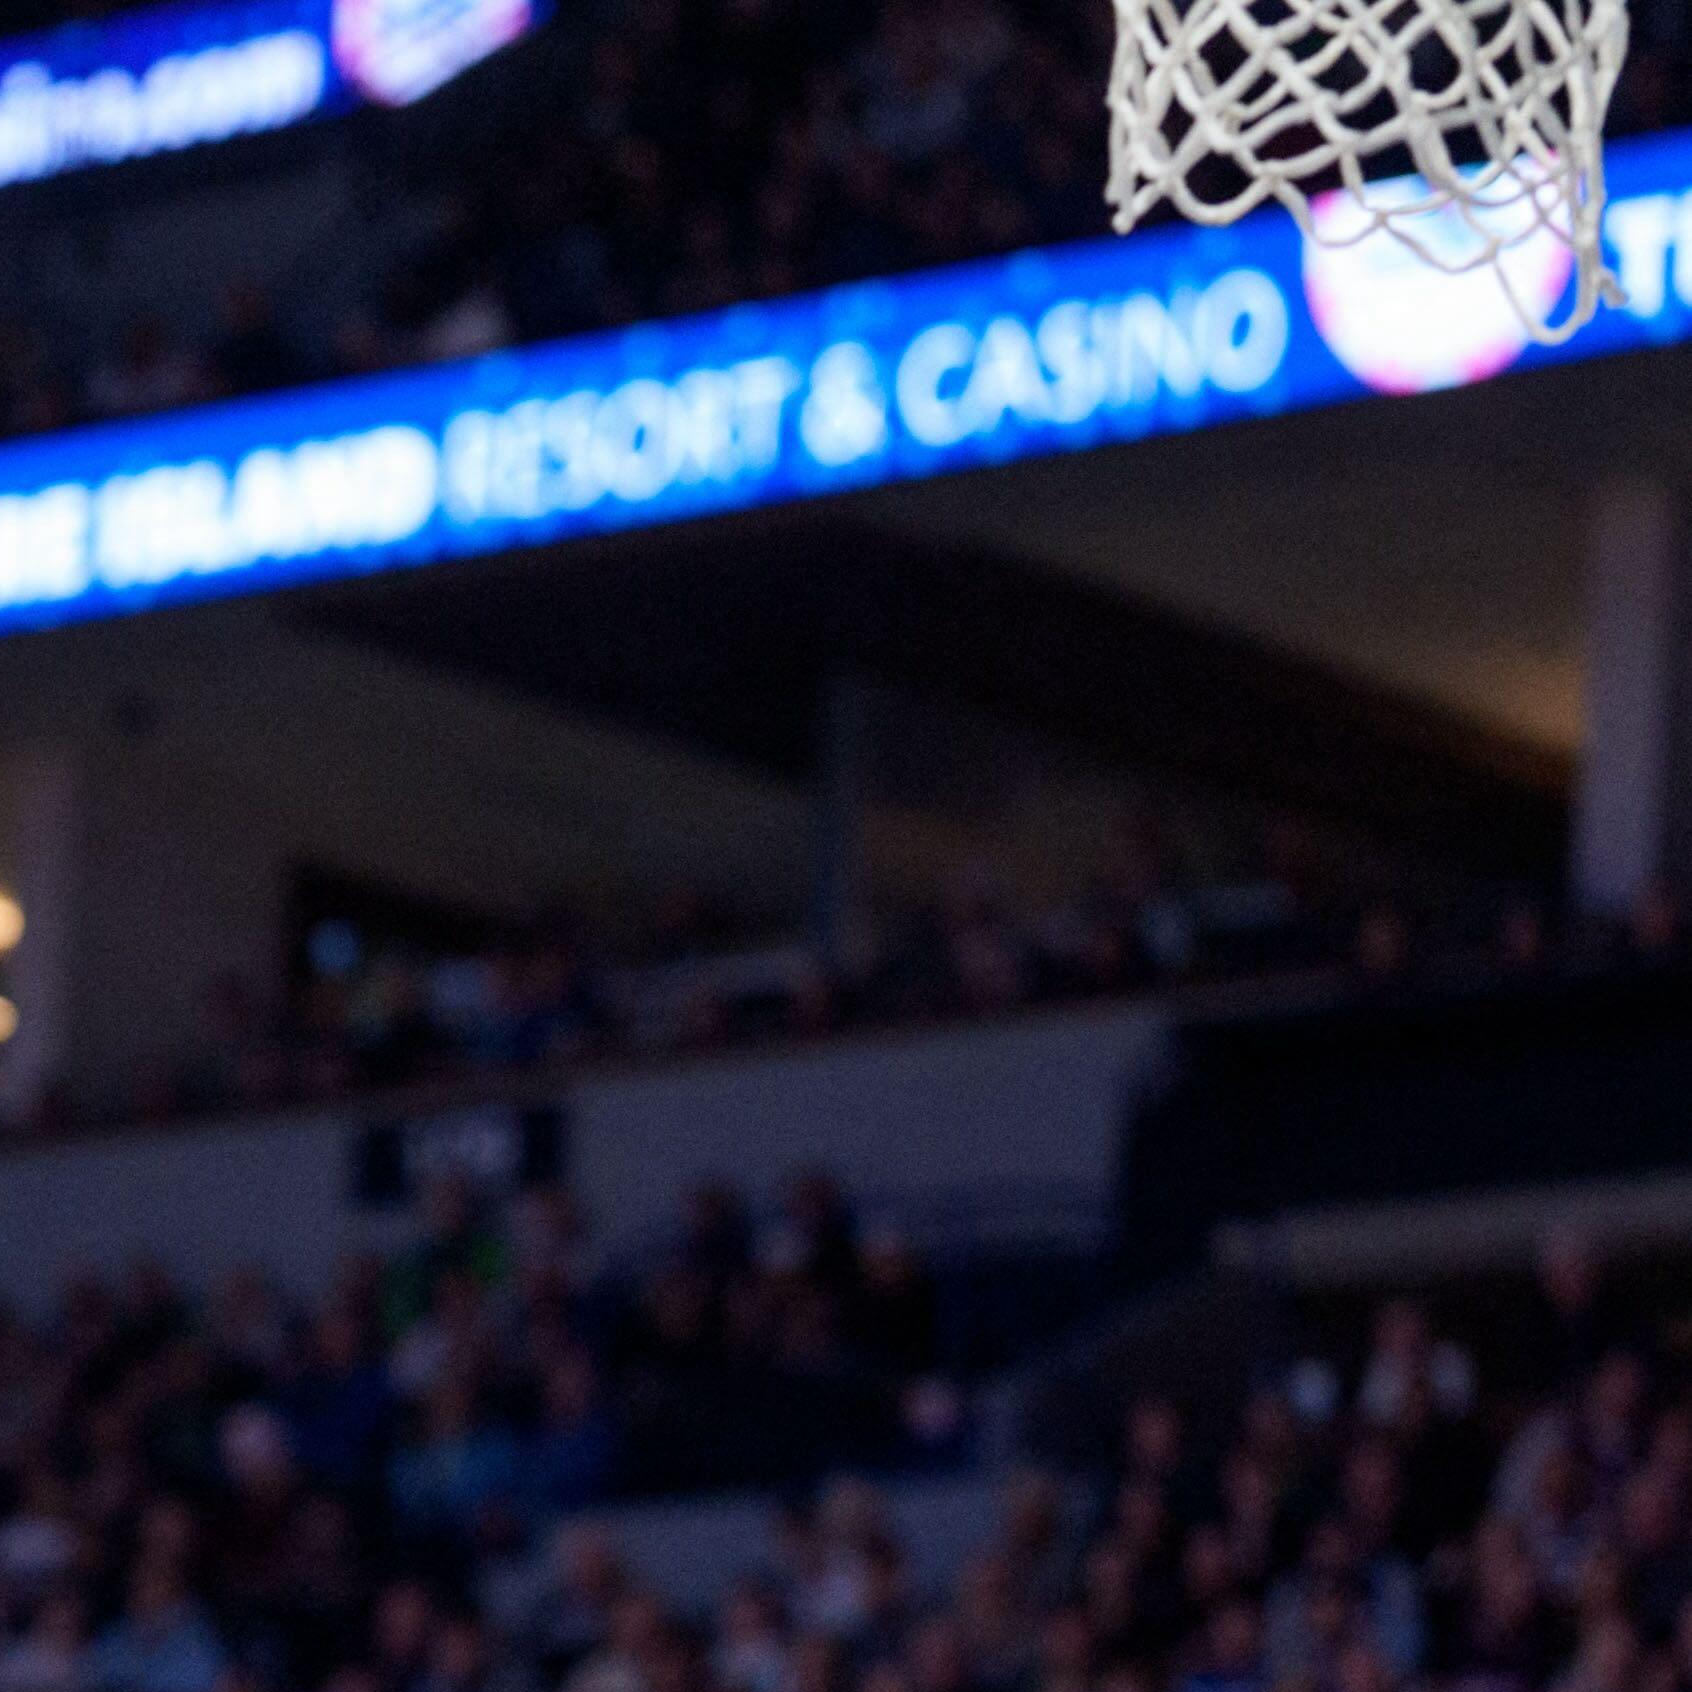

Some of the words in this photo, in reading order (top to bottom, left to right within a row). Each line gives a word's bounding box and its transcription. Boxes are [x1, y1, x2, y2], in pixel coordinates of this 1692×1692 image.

[94, 423, 438, 589] ISLAND
[443, 355, 799, 523] RESORT
[801, 340, 887, 467] &
[898, 268, 1289, 447] CASINO
